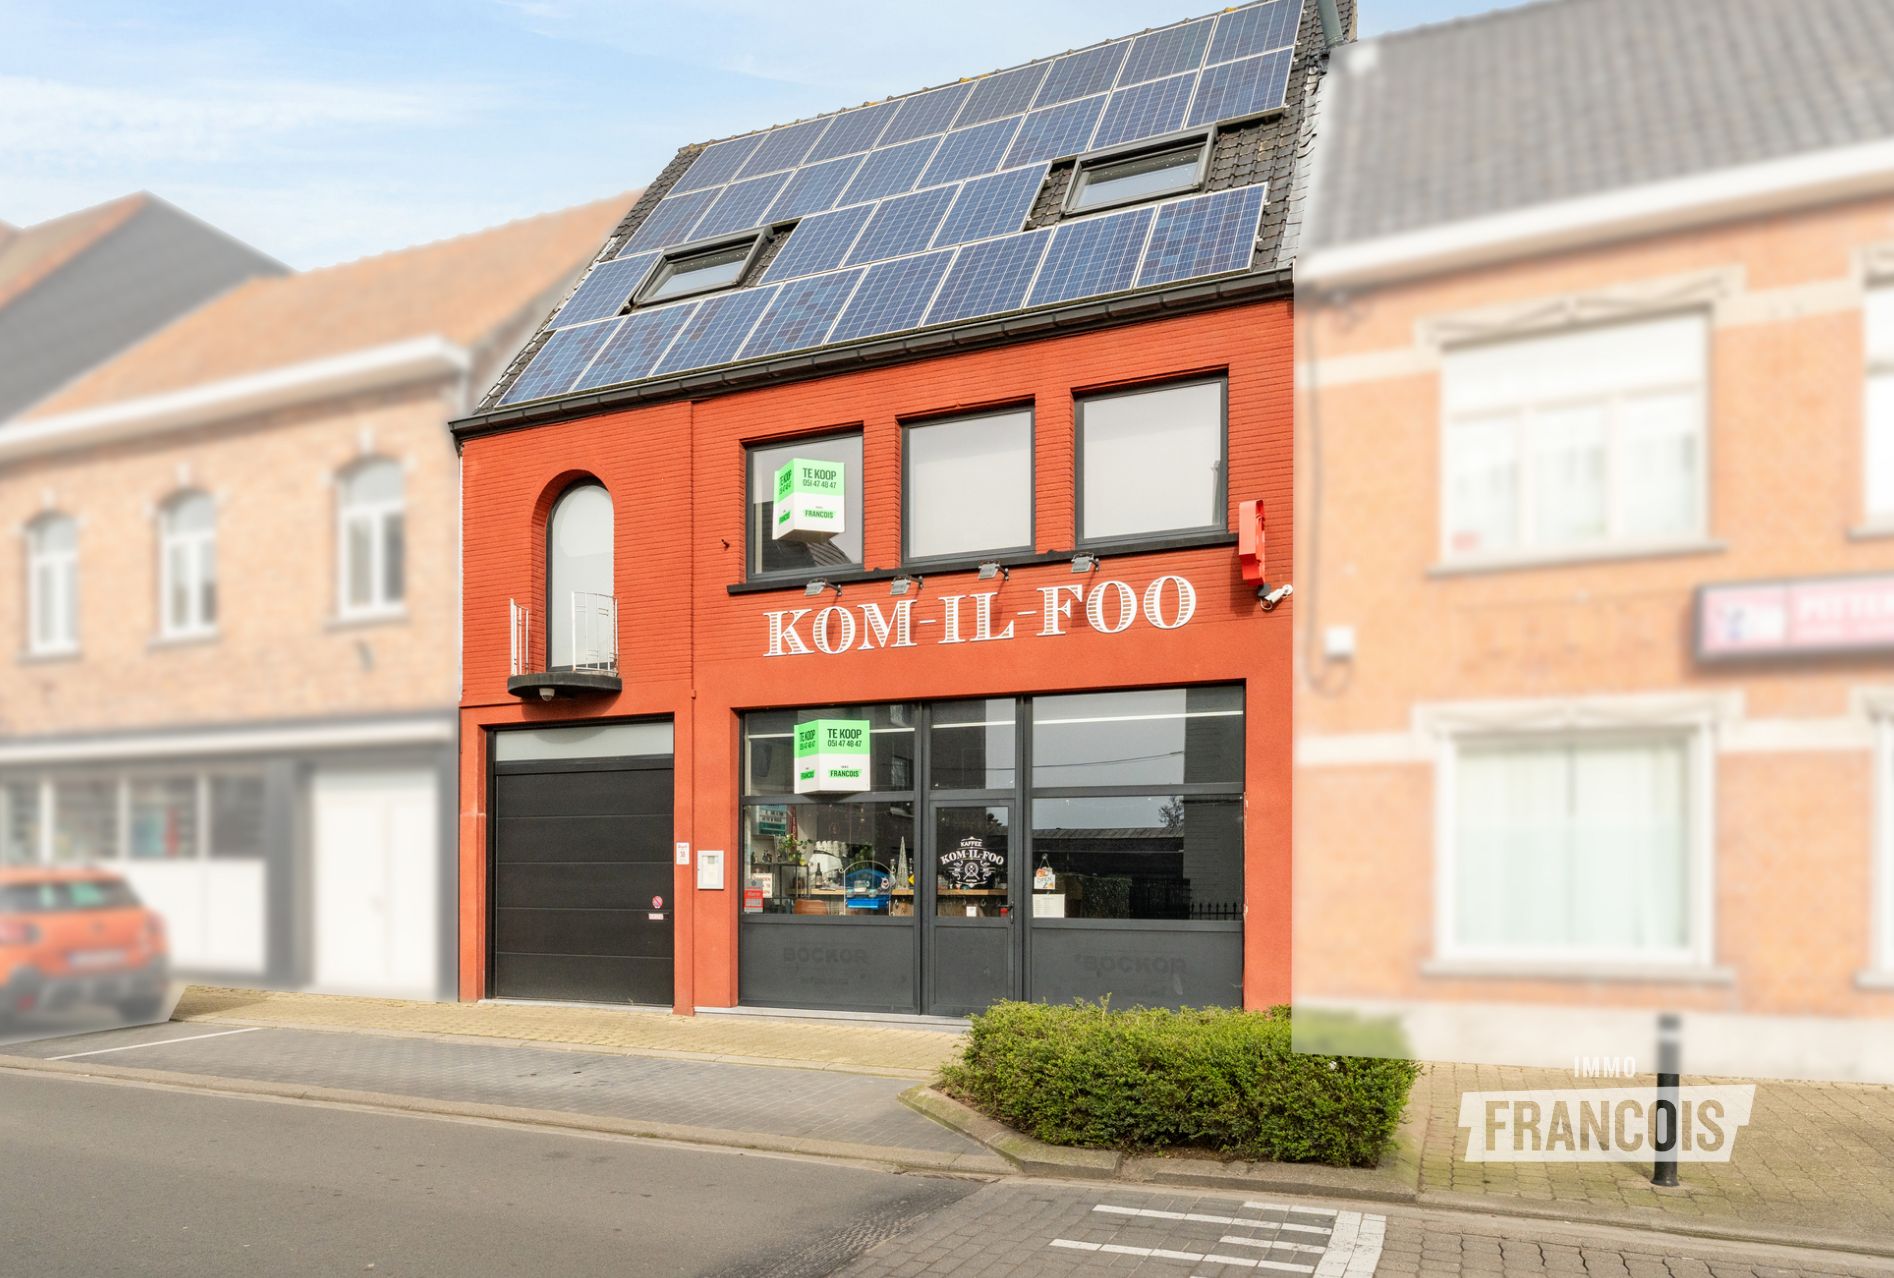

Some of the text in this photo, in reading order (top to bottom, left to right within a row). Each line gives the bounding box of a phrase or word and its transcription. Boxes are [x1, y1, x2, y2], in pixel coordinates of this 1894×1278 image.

[803, 467, 813, 479] TE
[814, 469, 837, 481] KOOP
[805, 509, 834, 519] FRANCOIS
[763, 575, 1197, 657] KOM-IL-FOO
[827, 728, 862, 740] TE KOOP
[827, 740, 837, 748] 051
[838, 740, 846, 748] 47
[855, 740, 862, 748] 47
[830, 769, 860, 778] FRANCOIS
